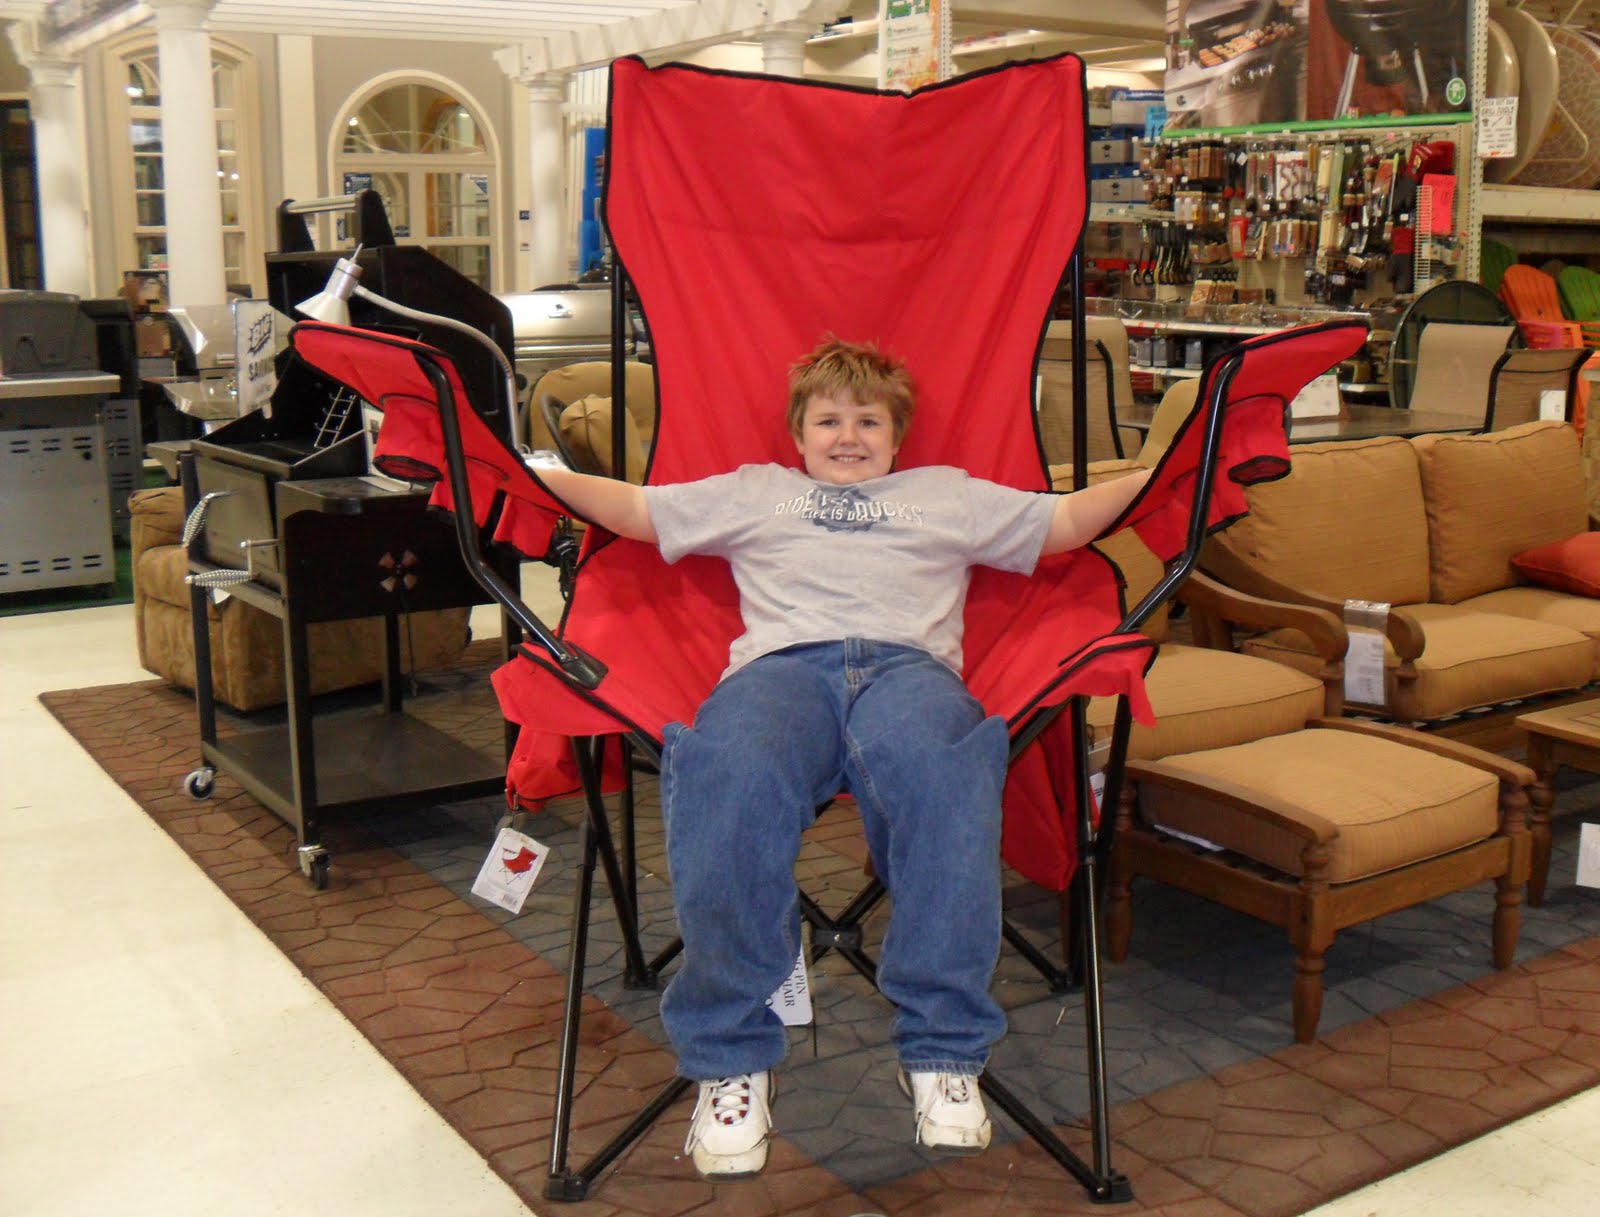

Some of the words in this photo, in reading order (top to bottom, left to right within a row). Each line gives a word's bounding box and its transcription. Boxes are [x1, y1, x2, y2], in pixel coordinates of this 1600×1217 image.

[830, 507, 844, 520] IS
[854, 501, 924, 528] DUCKS
[781, 977, 795, 1007] HAIR
[795, 975, 806, 995] PIN
